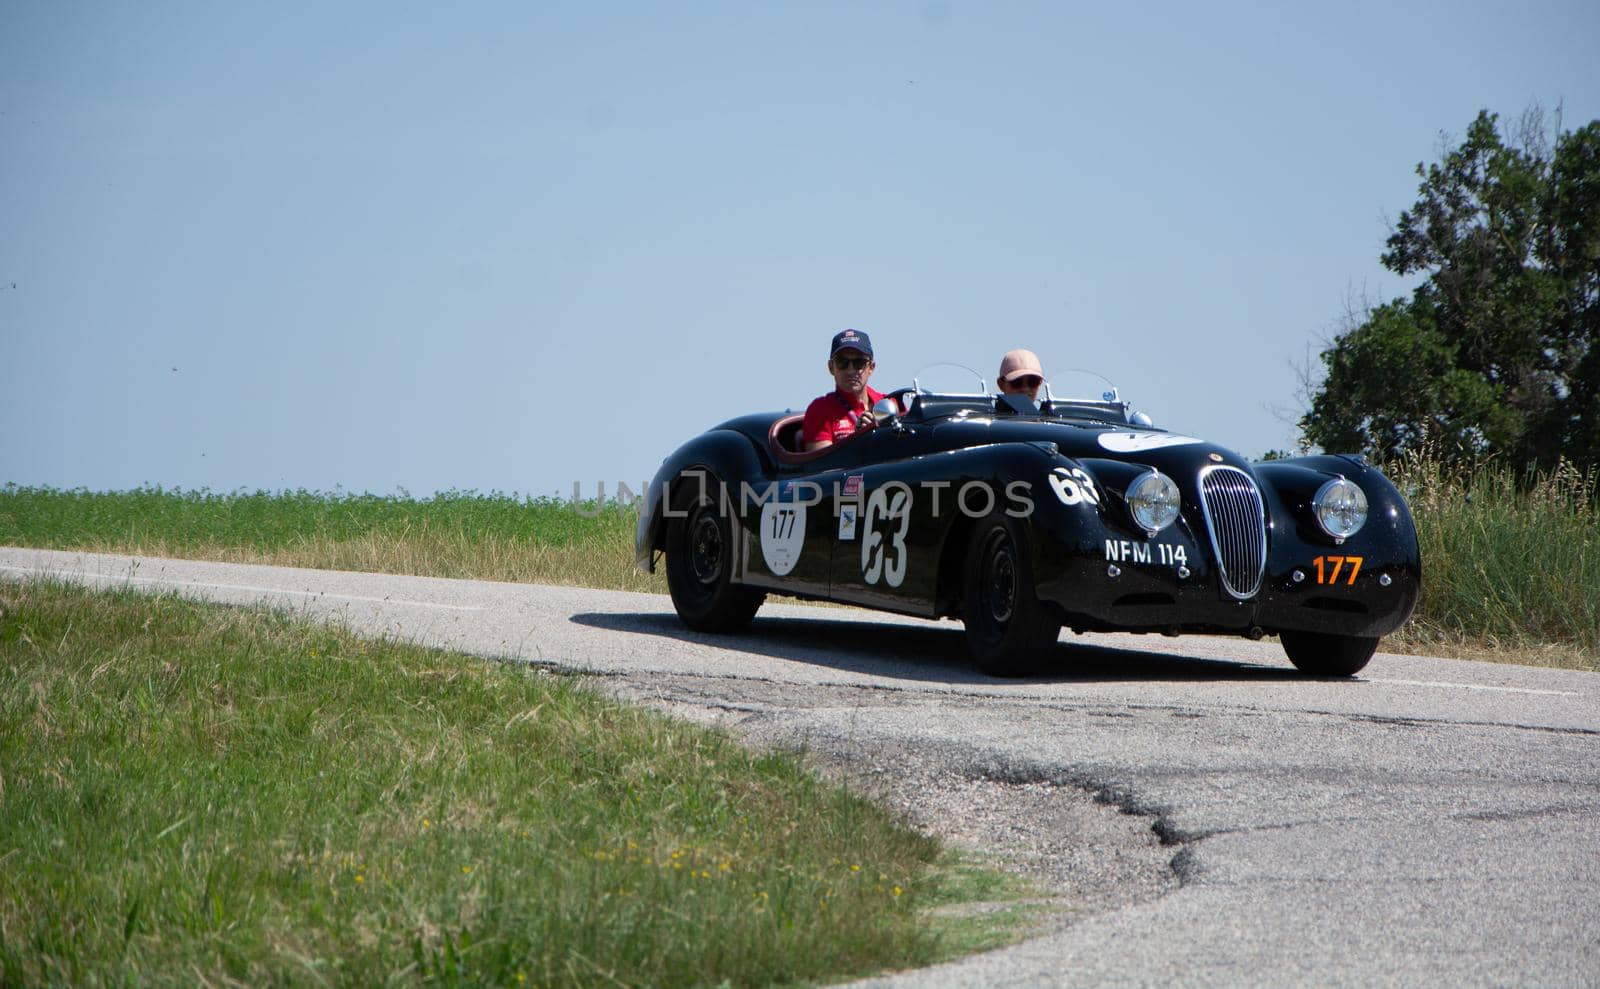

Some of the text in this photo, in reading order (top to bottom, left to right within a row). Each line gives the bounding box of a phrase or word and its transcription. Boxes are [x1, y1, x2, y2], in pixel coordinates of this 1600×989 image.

[772, 509, 798, 539] 177
[861, 488, 911, 588] 63
[1105, 539, 1187, 566] NFM 114
[1313, 555, 1364, 585] 177
